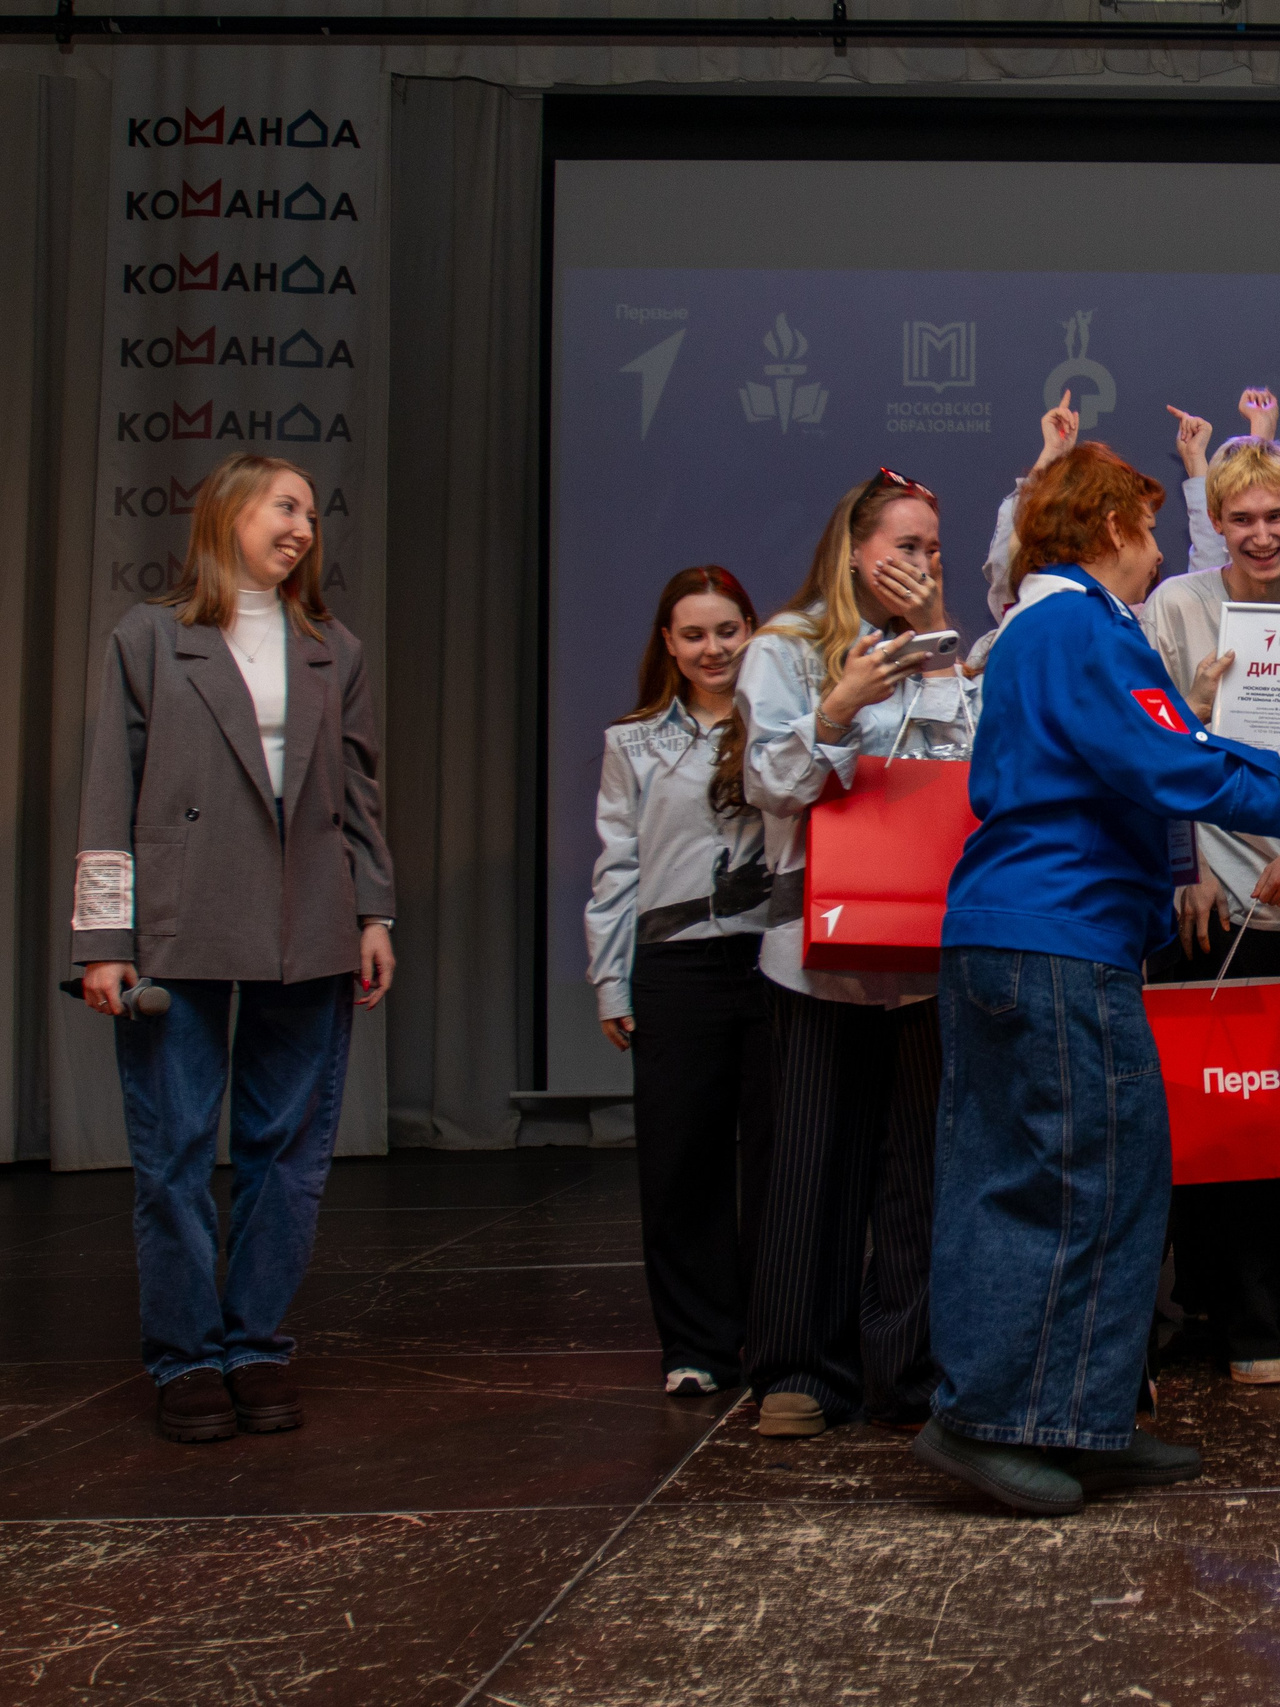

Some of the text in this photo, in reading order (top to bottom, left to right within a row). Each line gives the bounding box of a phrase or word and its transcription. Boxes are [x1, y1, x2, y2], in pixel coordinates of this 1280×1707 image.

[127, 105, 361, 149] КОМАНДА
[125, 178, 358, 222] КОМАНДА
[123, 251, 357, 295] КОМАНДА
[615, 303, 689, 325] Первые
[120, 325, 355, 369] КОМАНДА
[117, 399, 352, 443] КОМАНДА
[886, 401, 992, 416] МОСКОВСКОЕ
[886, 418, 992, 433] ОБРАЗОВАНИЕ
